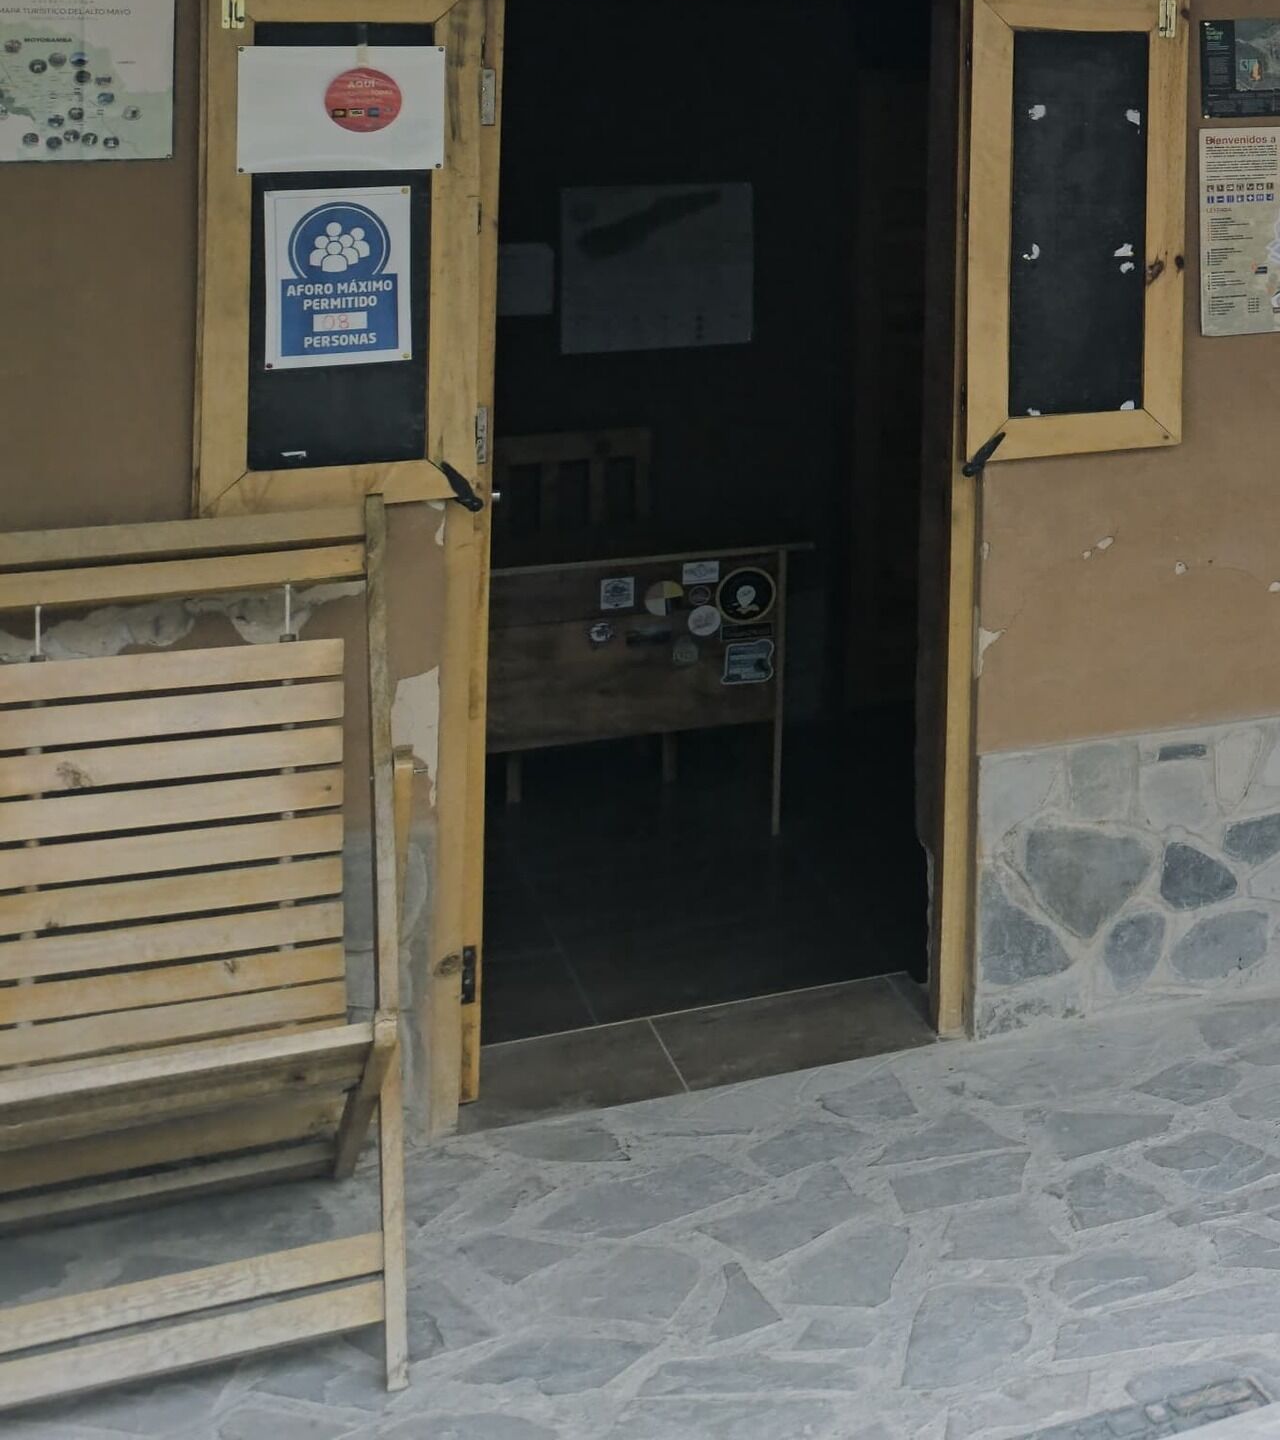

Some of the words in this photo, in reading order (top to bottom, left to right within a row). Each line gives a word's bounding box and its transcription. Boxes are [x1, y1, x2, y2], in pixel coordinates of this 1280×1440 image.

[1205, 135, 1267, 145] Bienvenidos
[286, 283, 334, 297] AFORO
[336, 279, 393, 294] MÁXIMO
[303, 295, 378, 311] PERMITIDO
[322, 314, 350, 329] 08
[304, 332, 377, 349] PERSONAS
